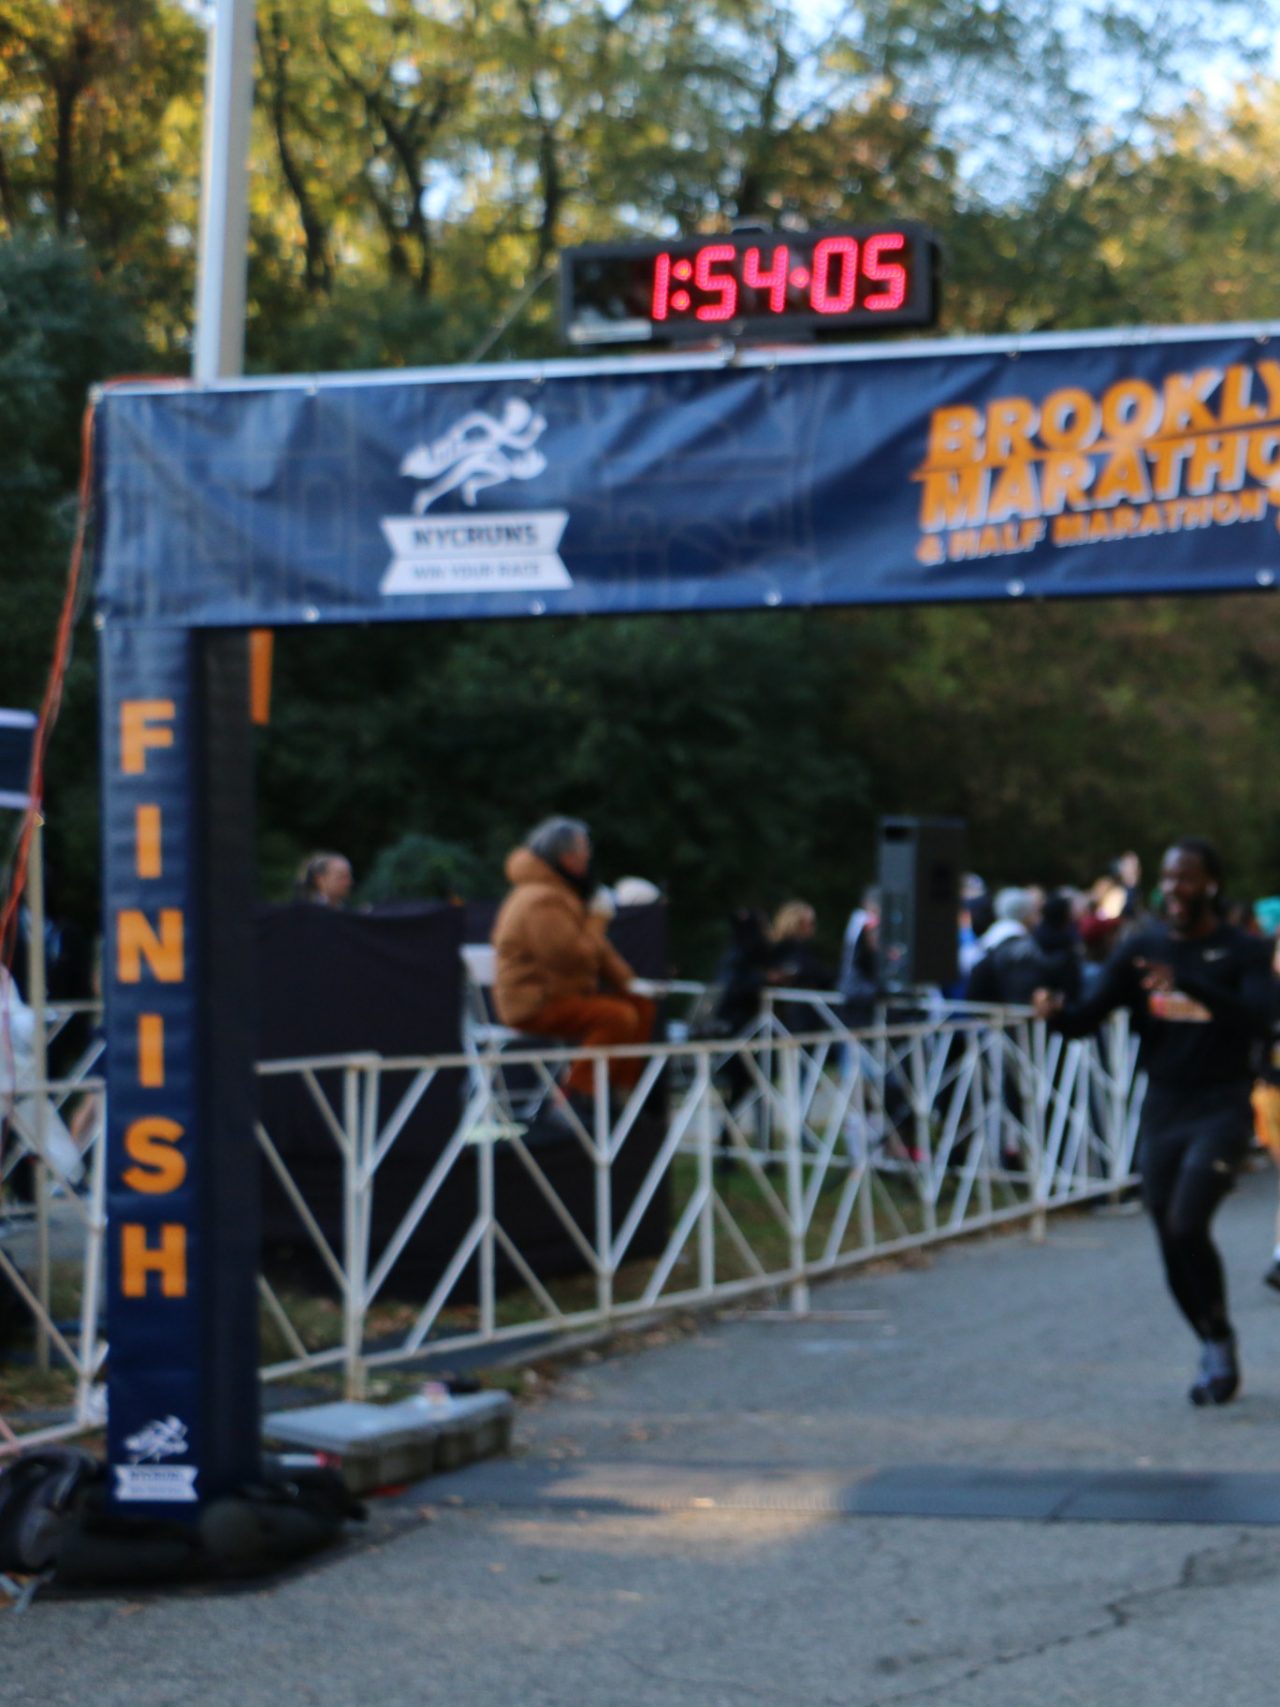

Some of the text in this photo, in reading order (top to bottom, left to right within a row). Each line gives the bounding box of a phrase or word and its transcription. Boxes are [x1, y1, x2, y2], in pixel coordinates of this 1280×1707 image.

[412, 523, 538, 547] NYCRUNS
[949, 516, 1047, 562] HALF
[1051, 488, 1269, 548] MARATHON
[116, 699, 188, 1298] FINISH
